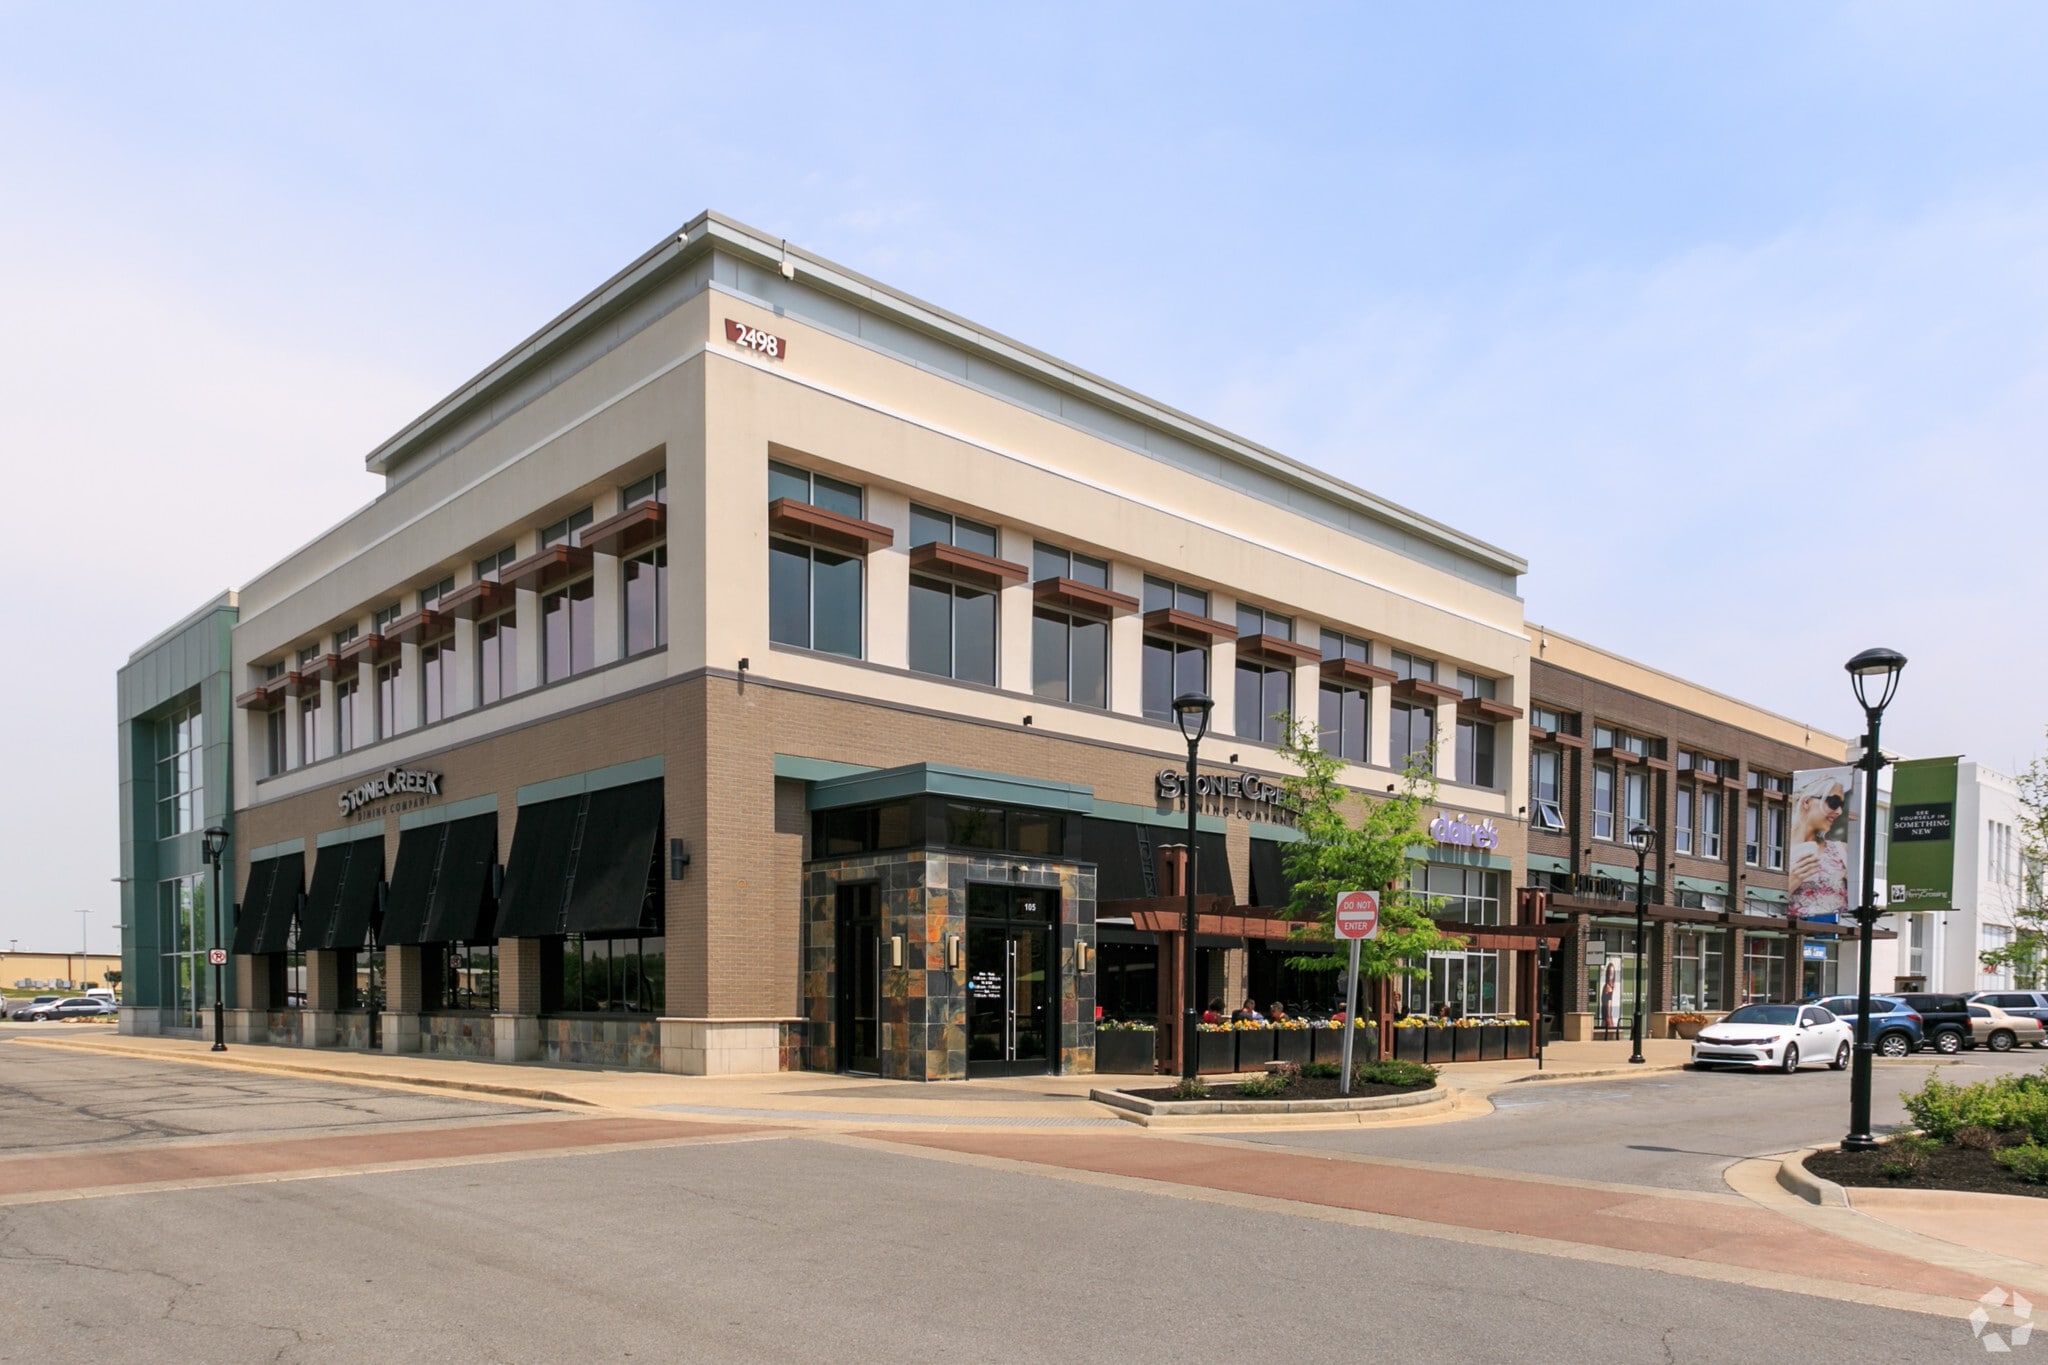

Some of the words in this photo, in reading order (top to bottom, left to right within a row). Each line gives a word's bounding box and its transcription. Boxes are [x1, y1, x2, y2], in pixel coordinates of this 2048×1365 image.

[736, 323, 778, 357] 2498
[1157, 769, 1304, 816] STONECRE
[357, 806, 387, 821] DINING
[390, 796, 430, 813] COMPANY
[1179, 800, 1230, 818] DNING
[1894, 820, 1950, 829] SOMETHING
[1912, 828, 1933, 836] NEW
[1024, 903, 1036, 911] 105
[1343, 902, 1354, 910] DO
[1357, 900, 1371, 909] NOT
[1344, 921, 1368, 930] ENTER
